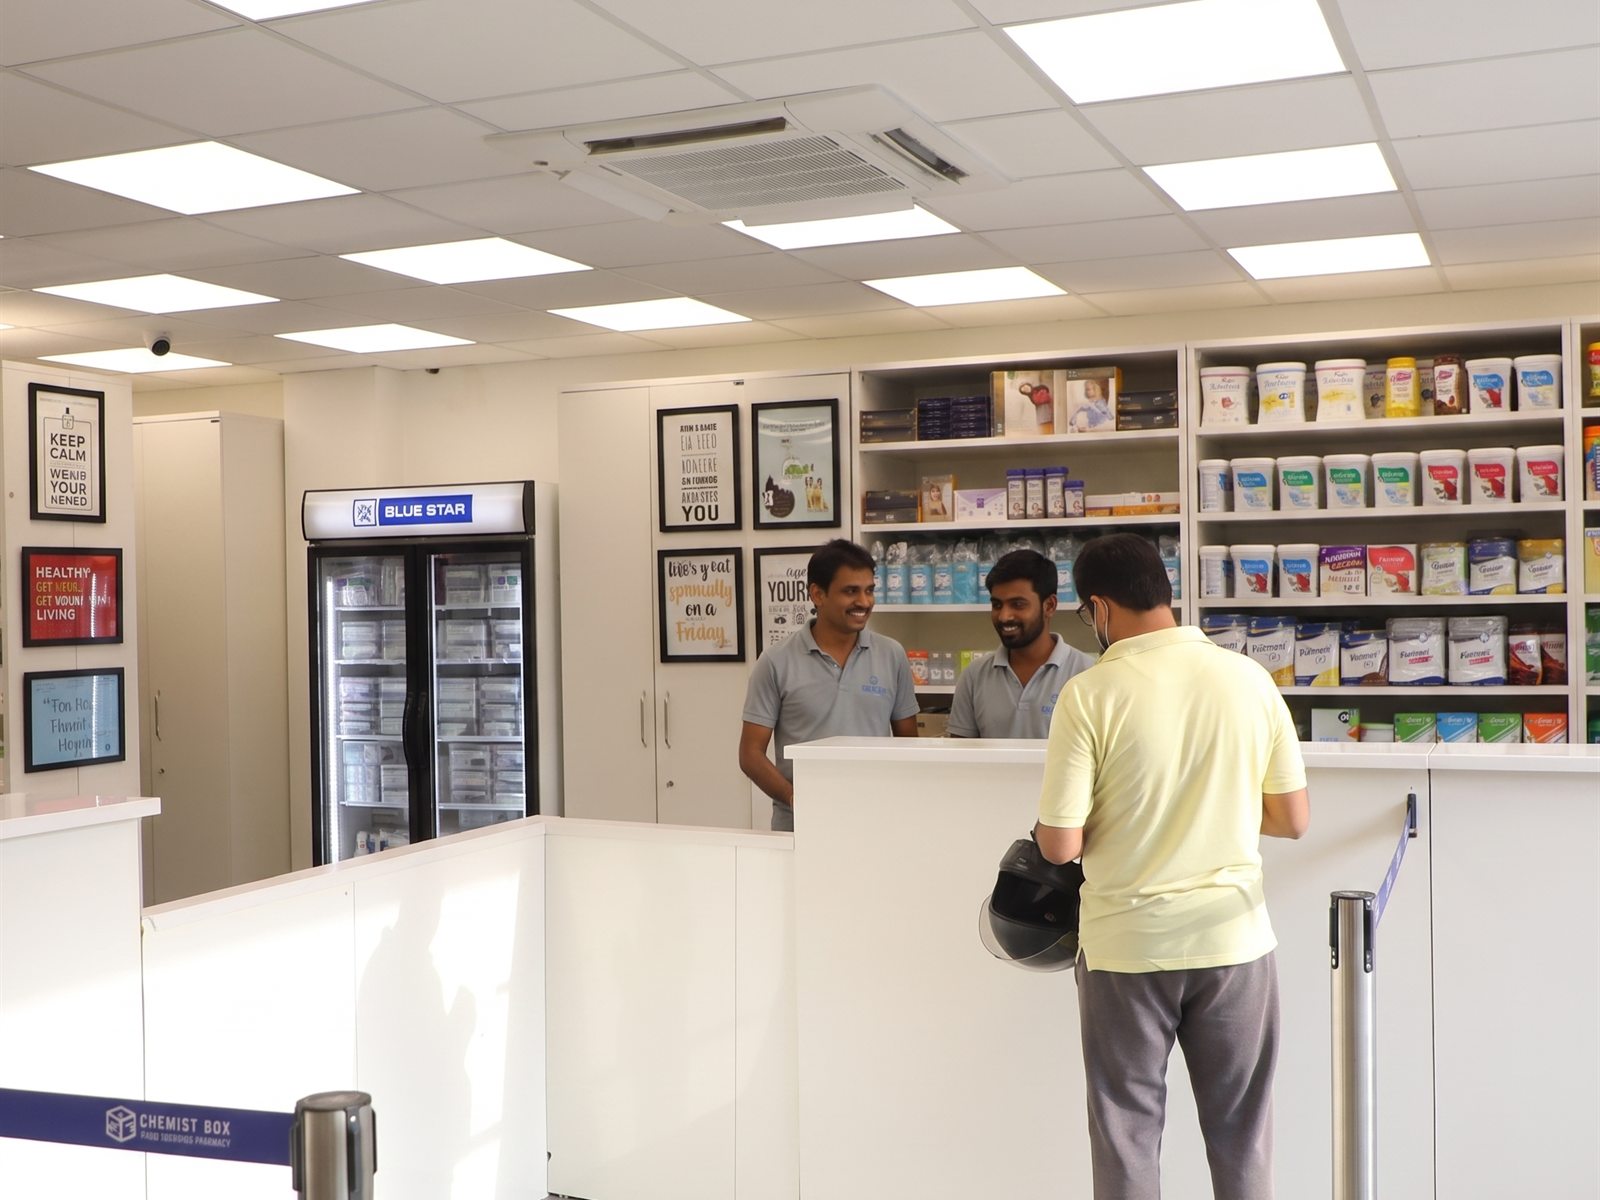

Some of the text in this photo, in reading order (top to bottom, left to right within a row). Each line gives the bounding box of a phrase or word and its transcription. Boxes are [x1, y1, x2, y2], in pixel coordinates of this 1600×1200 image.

[50, 433, 85, 447] KEEP
[50, 448, 86, 461] CALM
[50, 481, 87, 495] YOUR
[51, 495, 87, 506] NENED
[384, 503, 465, 517] BLUE STAR
[681, 504, 719, 522] YOU
[36, 567, 91, 579] HEALTHY
[36, 582, 53, 593] GET
[36, 595, 53, 607] GET
[37, 608, 76, 620] LIVING
[685, 603, 717, 616] on a
[140, 1114, 231, 1136] CHEMIST BOX
